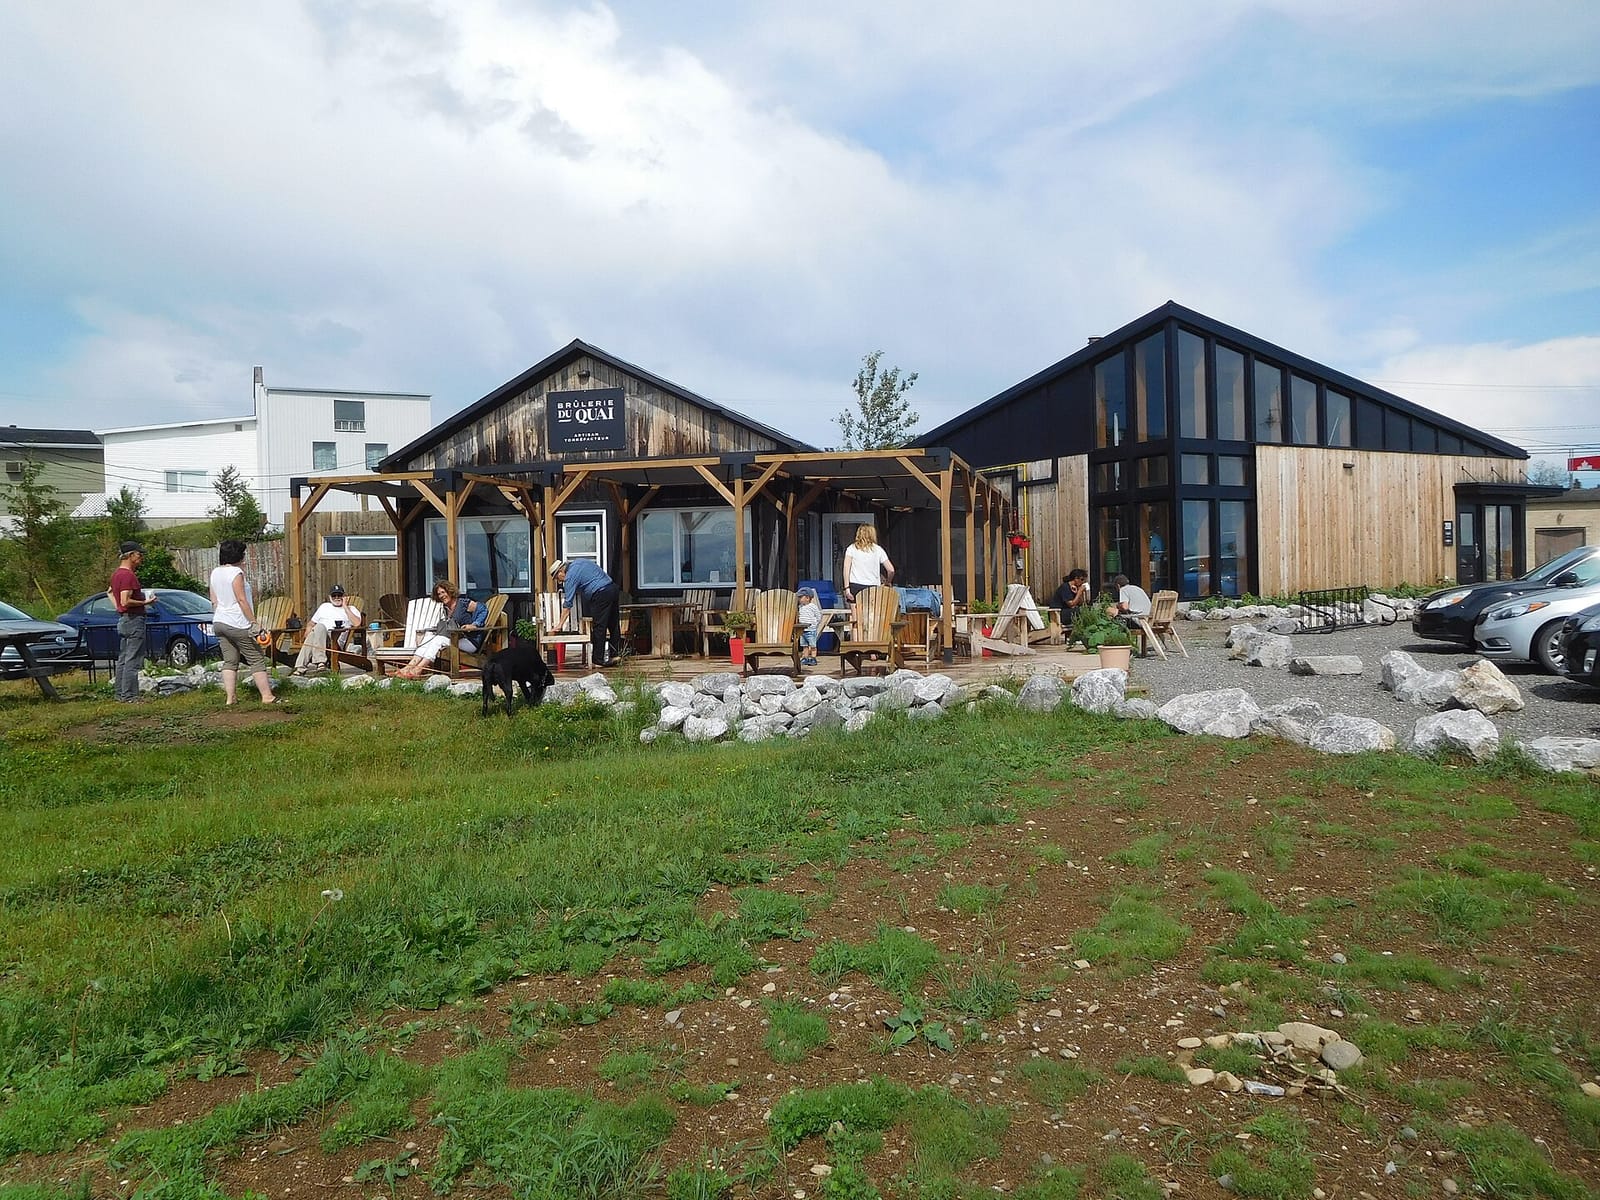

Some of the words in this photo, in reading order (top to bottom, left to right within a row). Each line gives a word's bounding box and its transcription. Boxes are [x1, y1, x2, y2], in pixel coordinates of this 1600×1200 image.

[557, 399, 614, 409] BRÛLERIE
[557, 409, 572, 419] DU
[575, 407, 614, 424] QUAI
